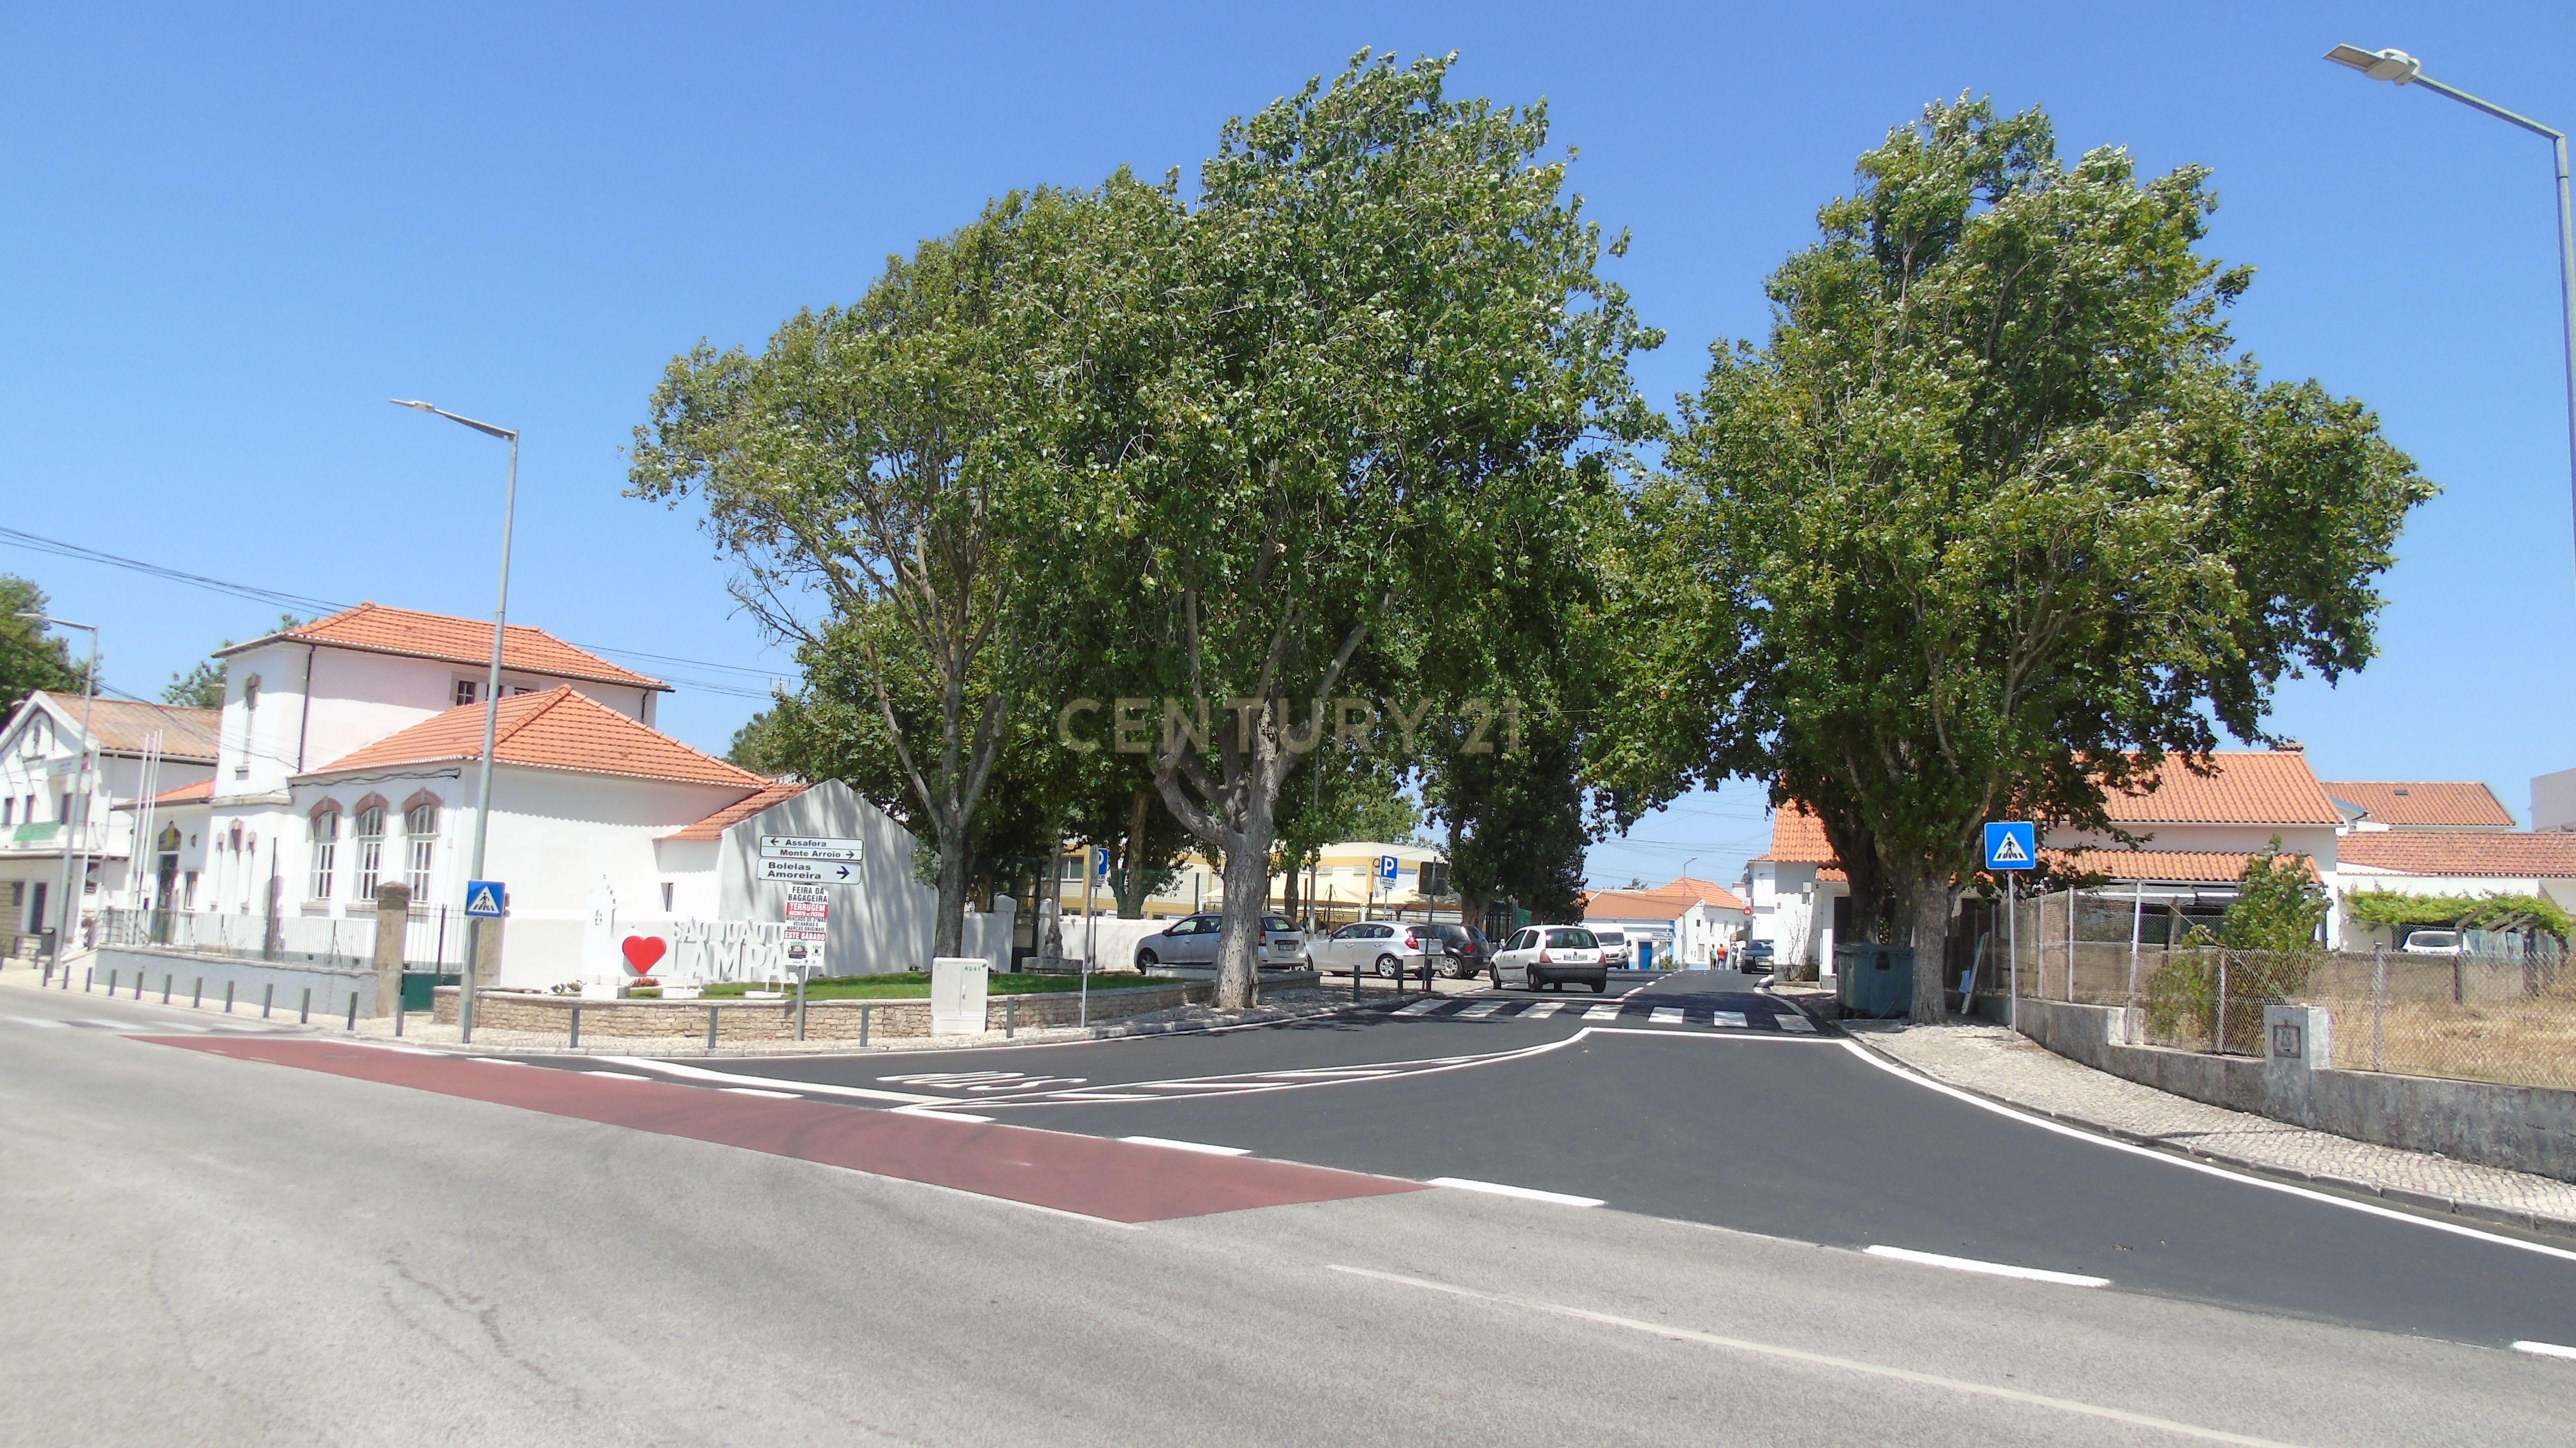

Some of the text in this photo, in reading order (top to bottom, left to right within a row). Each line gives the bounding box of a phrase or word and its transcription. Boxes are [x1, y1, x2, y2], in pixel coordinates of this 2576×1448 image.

[786, 839, 826, 847] Assafora
[768, 862, 811, 870] Bolelas
[1384, 857, 1394, 876] P
[768, 870, 821, 879] Amoreira
[788, 894, 827, 902] BAGAGEIRA
[790, 903, 826, 912] TERRUGEM
[672, 916, 710, 942] SÃO
[716, 916, 766, 944] JOÃO
[801, 932, 826, 940] SÁBADO
